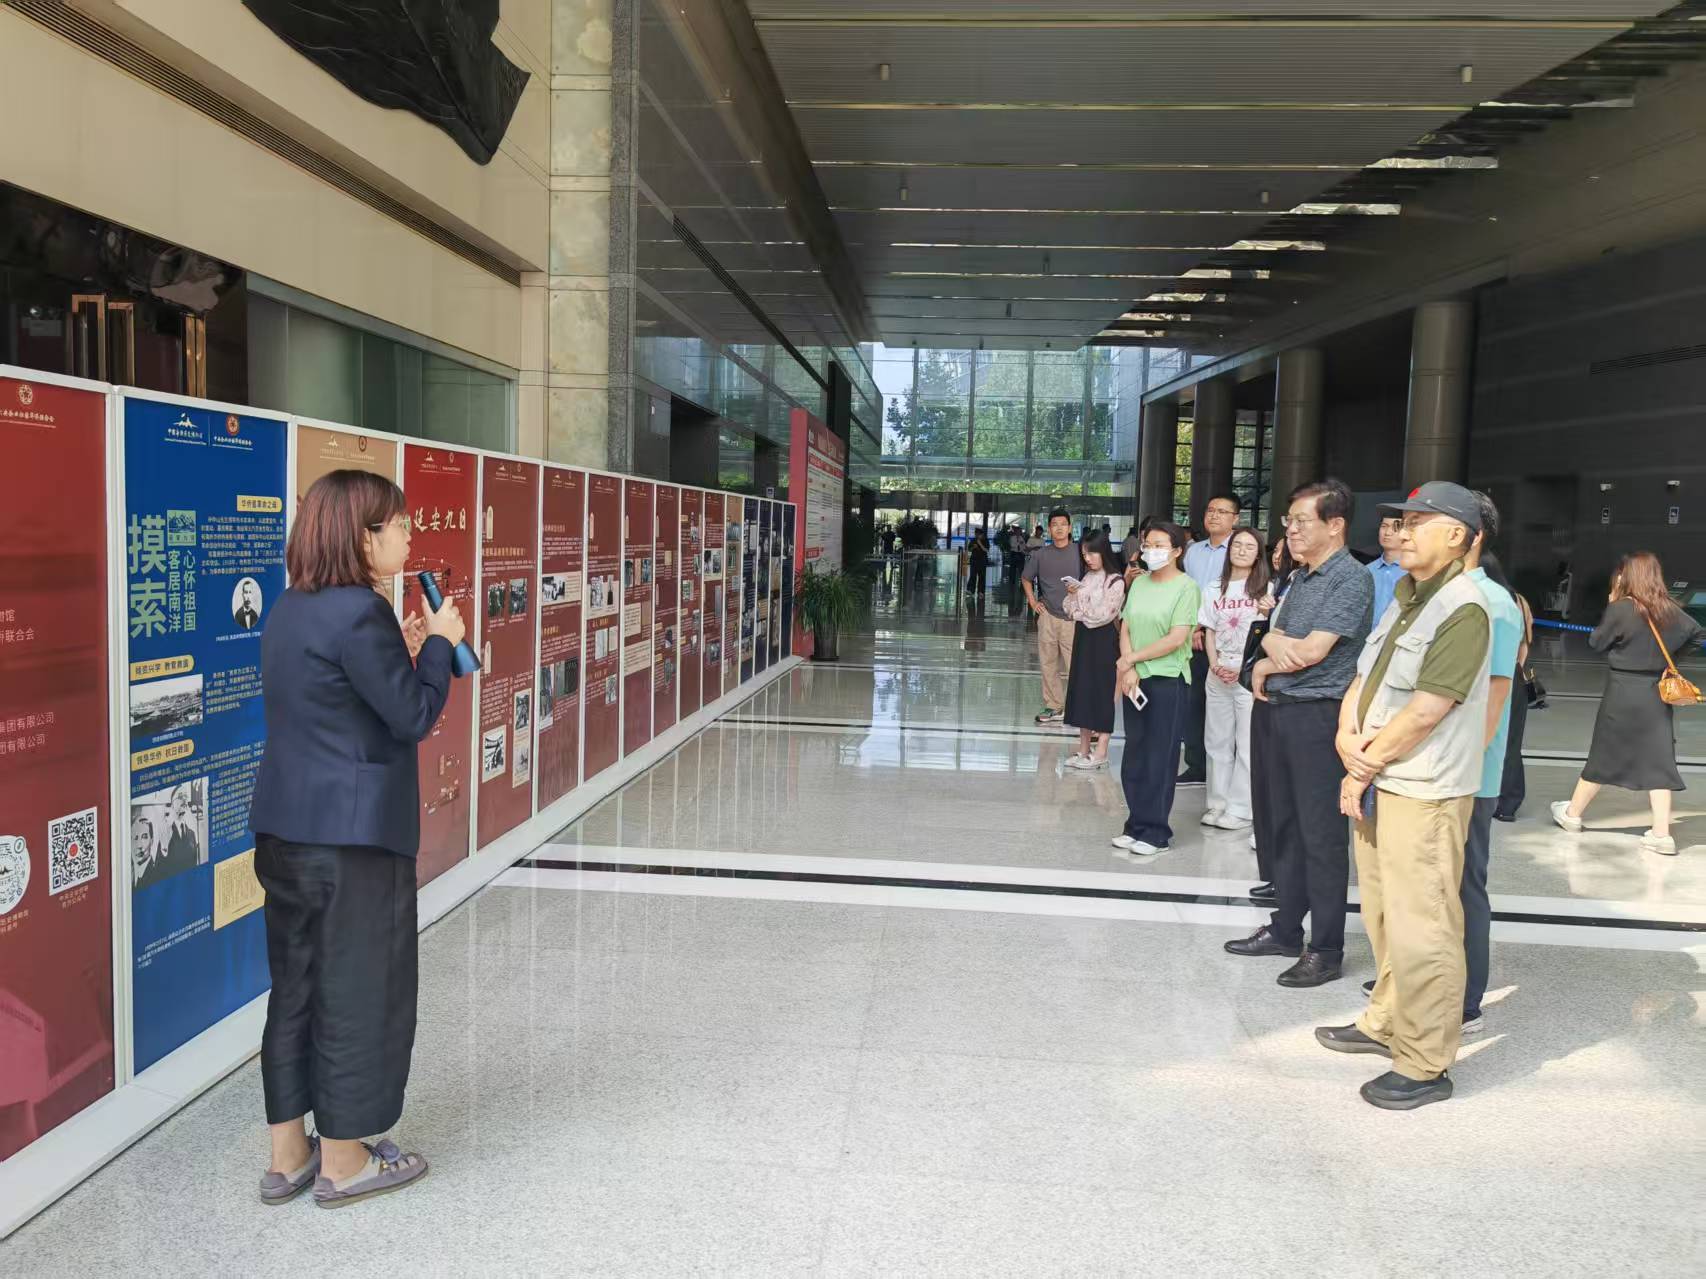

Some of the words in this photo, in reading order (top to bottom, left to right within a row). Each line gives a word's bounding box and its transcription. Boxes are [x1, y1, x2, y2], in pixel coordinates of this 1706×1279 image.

[413, 506, 466, 532] 延安九日
[128, 513, 167, 638] 摸索
[168, 548, 181, 633] 客居南洋
[183, 550, 196, 632] 心怀祖国
[1213, 597, 1255, 611] Mard
